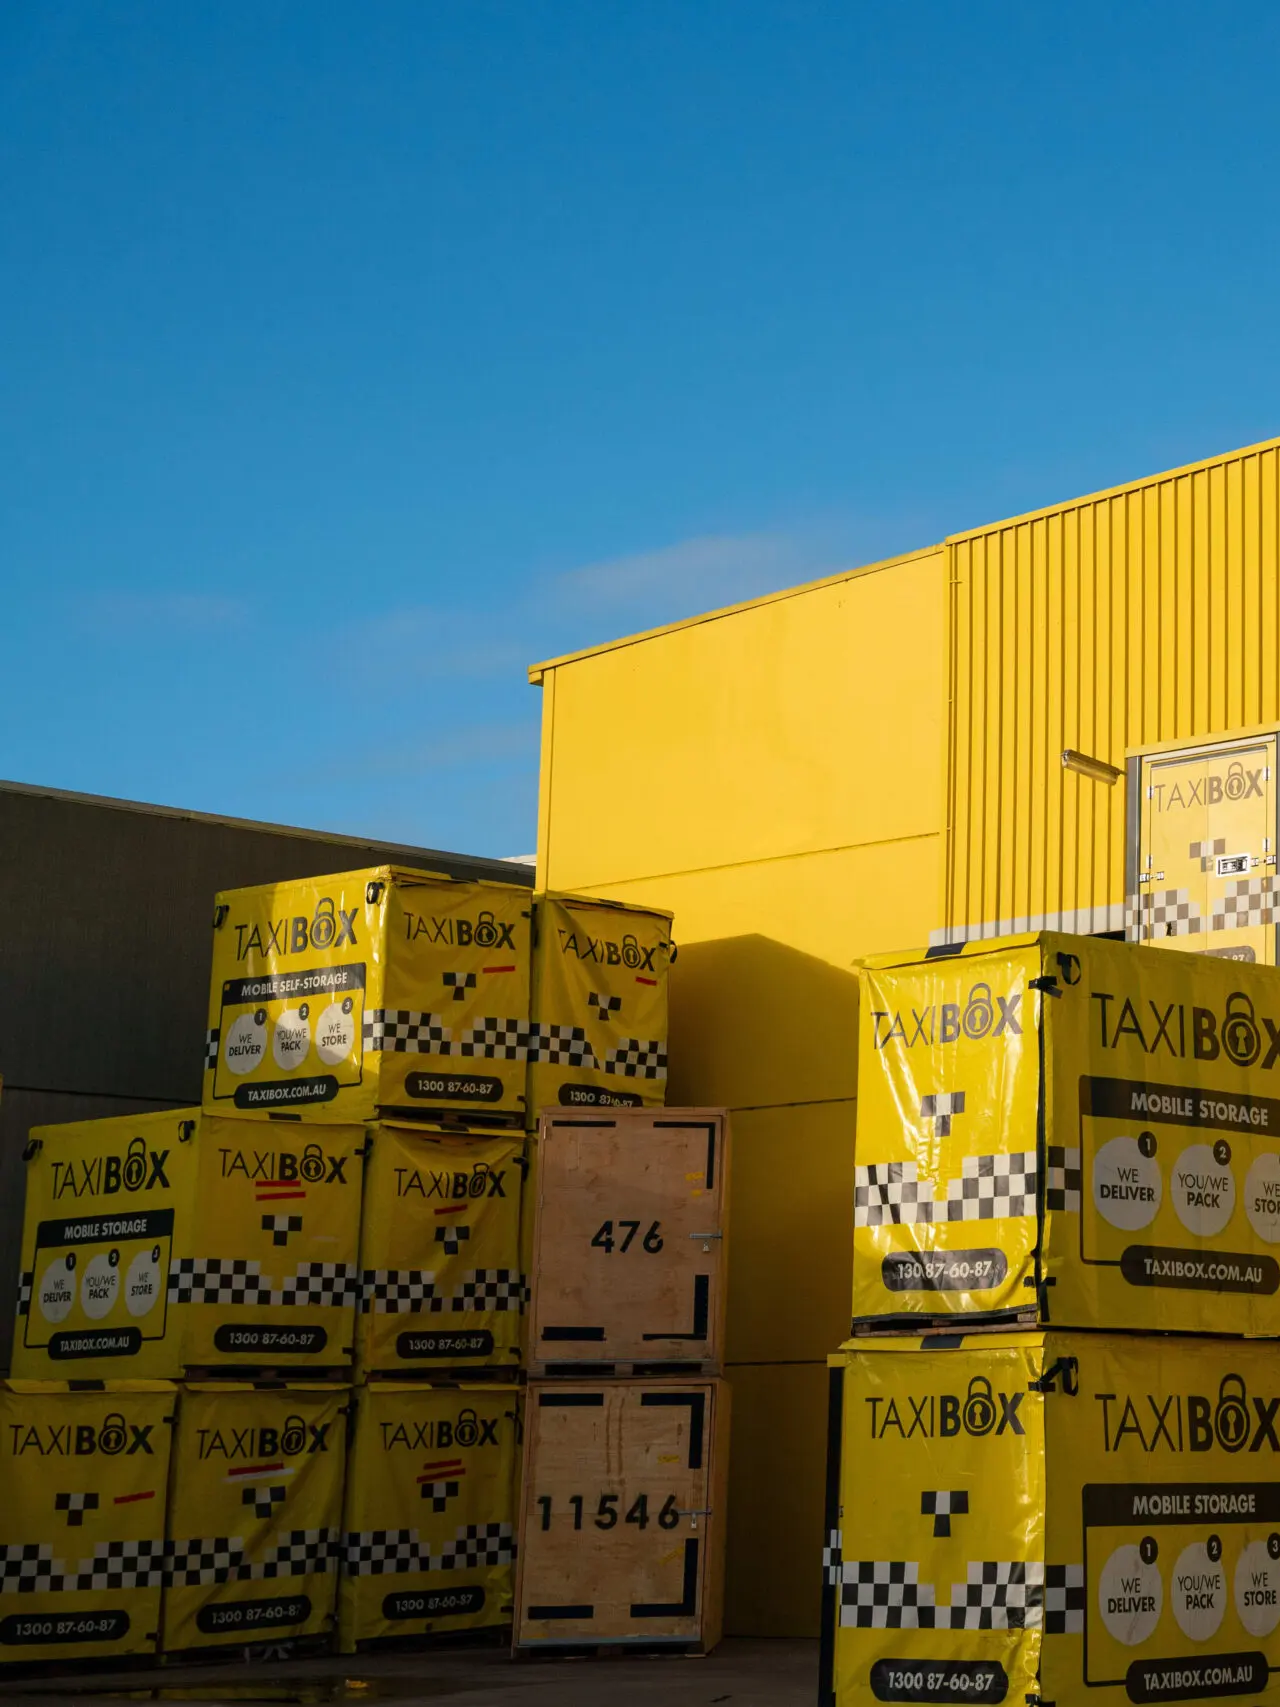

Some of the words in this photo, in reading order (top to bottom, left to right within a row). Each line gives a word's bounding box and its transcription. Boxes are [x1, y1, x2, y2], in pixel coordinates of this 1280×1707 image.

[1155, 762, 1264, 812] TAXIBOX
[235, 897, 359, 961] TAXIBOX
[404, 911, 516, 950] TAXIBOX
[558, 929, 657, 972] TAXIBOX
[242, 982, 277, 996] MOBILE
[280, 972, 347, 992] SELF-STORAGE
[301, 1008, 306, 1016] 2
[346, 1001, 350, 1009] 3
[259, 1013, 262, 1021] 1
[870, 982, 1023, 1049] TAXIBOX
[277, 1028, 307, 1041] YOU/WE
[329, 1024, 340, 1032] WE
[239, 1034, 252, 1043] WE
[281, 1041, 301, 1051] PACK
[322, 1035, 346, 1046] STORE
[229, 1045, 261, 1056] DELIVER
[248, 1084, 326, 1101] TAXIBOX.COM.AU
[418, 1080, 444, 1092] 1300
[448, 1082, 493, 1093] 87-60-87
[570, 1091, 595, 1103] 1300
[1131, 1092, 1193, 1117] MOBILE
[1199, 1100, 1268, 1126] STORAGE
[1145, 1139, 1150, 1151] 1
[1219, 1147, 1226, 1159] 2
[51, 1137, 170, 1199] TAXIBOX
[219, 1144, 347, 1184] TAXIBOX
[394, 1163, 506, 1198] TAXIBOX
[1117, 1167, 1138, 1183] WE
[1178, 1173, 1228, 1192] YOU/WE
[1100, 1184, 1154, 1201] DELIVER
[1263, 1183, 1280, 1197] WE
[1187, 1192, 1220, 1208] PACK
[64, 1224, 99, 1239] MOBILE
[102, 1219, 147, 1236] STORAGE
[590, 1220, 664, 1254] 476
[139, 1272, 149, 1282] WE
[926, 1260, 992, 1278] 87-60-87
[1144, 1258, 1262, 1283] TAXIBOX.COM.AU
[53, 1280, 64, 1289] WE
[86, 1275, 116, 1286] YOU/WE
[43, 1291, 71, 1303] DELIVER
[89, 1288, 109, 1299] PACK
[131, 1284, 152, 1296] STORE
[60, 1336, 129, 1352] TAXIBOX.COM.AU
[229, 1332, 259, 1345] 1300
[262, 1333, 314, 1345] 87-60-87
[409, 1339, 435, 1350] 1300
[439, 1338, 484, 1349] 87-60-87
[865, 1375, 1025, 1438] TAXIBOX
[9, 1413, 155, 1456] TAXIBOX
[197, 1415, 331, 1459] TAXIBOX
[380, 1408, 499, 1450] TAXIBOX
[536, 1494, 681, 1531] 11546
[1133, 1496, 1190, 1516] MOBILE
[1194, 1494, 1256, 1514] STORAGE
[1145, 1544, 1151, 1556] 1
[1211, 1542, 1218, 1554] 2
[1272, 1540, 1279, 1552] 3
[1121, 1578, 1140, 1593] WE
[1178, 1574, 1220, 1592] YOU/WE
[1251, 1572, 1268, 1587] WE
[396, 1600, 423, 1612] 1300
[1108, 1597, 1155, 1614] DELIVER
[1186, 1594, 1214, 1610] PACK
[1244, 1591, 1277, 1606] STORE
[212, 1611, 242, 1624] 1300
[15, 1623, 52, 1636] 1300
[56, 1620, 116, 1633] 87-60-87
[888, 1671, 923, 1689] 1300
[927, 1673, 994, 1691] 87-60-87
[1144, 1665, 1253, 1691] TAXIBOX.COM.AU
